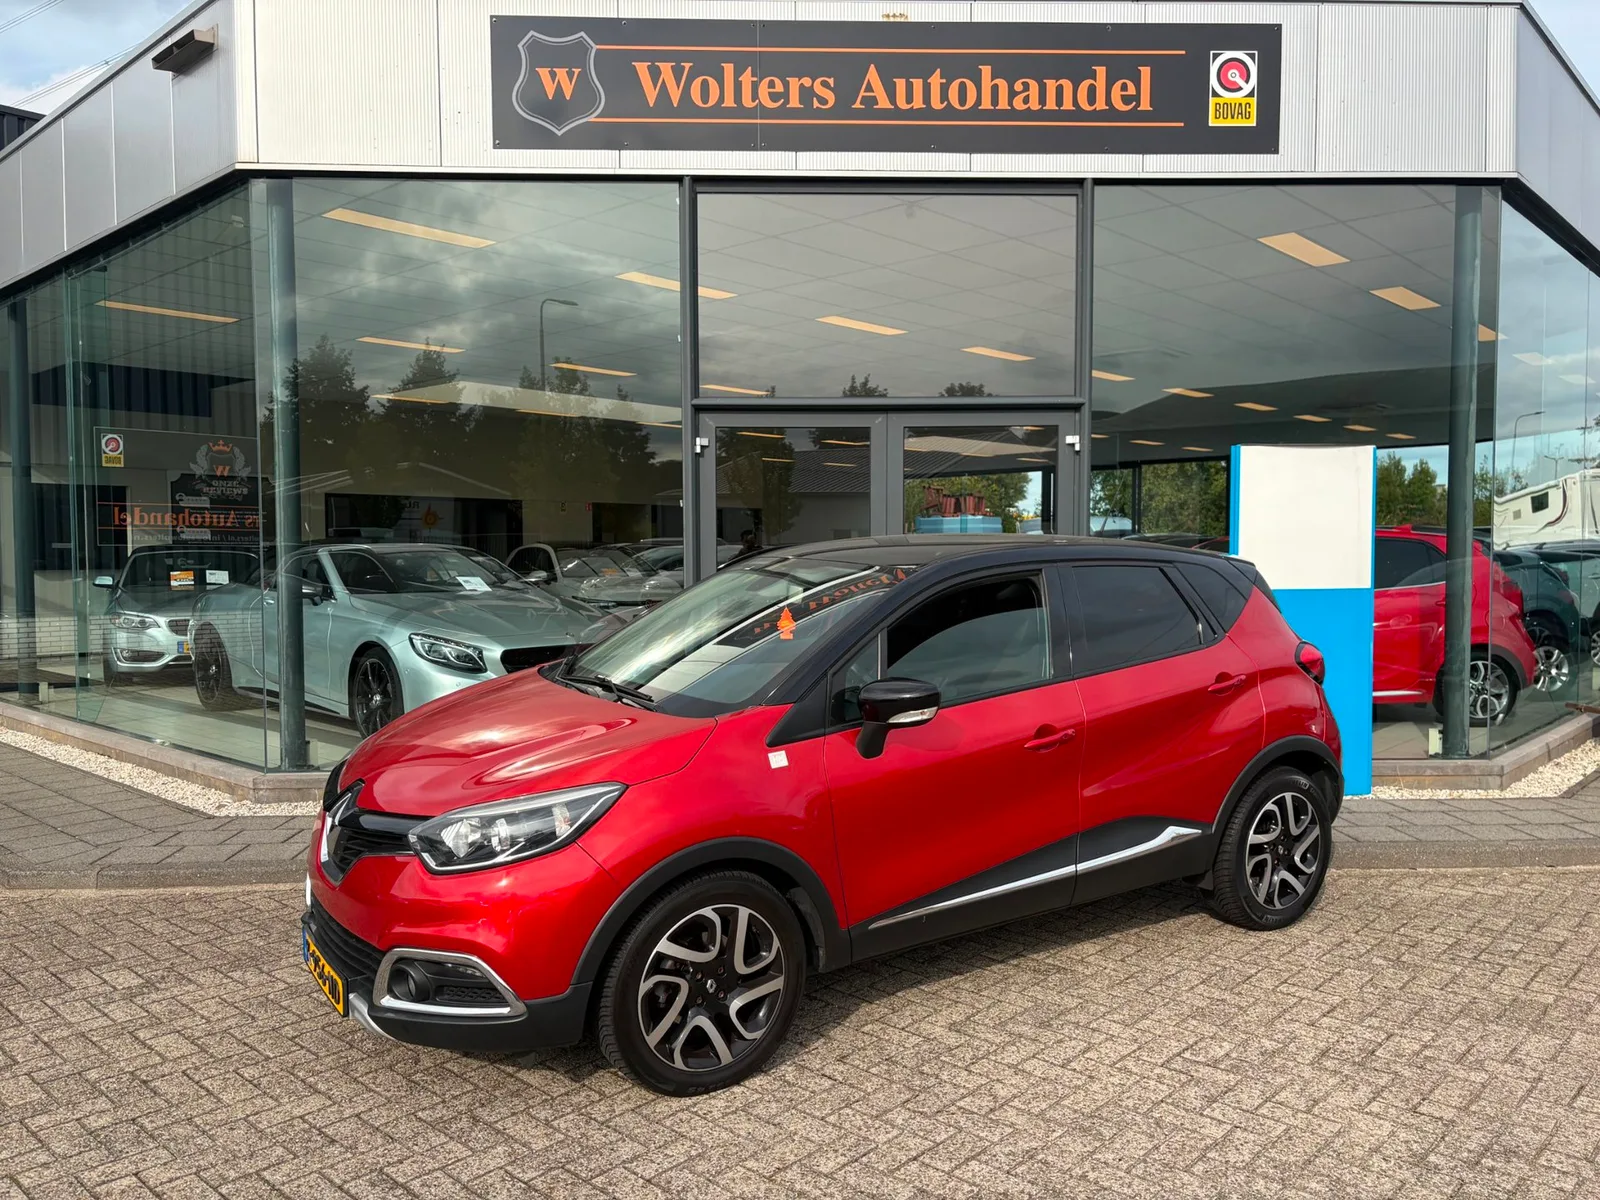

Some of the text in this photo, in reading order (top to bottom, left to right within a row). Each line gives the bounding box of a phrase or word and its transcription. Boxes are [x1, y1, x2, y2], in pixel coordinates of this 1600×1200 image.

[535, 67, 582, 101] W
[632, 61, 1153, 111] Wolters Autohandel
[1214, 102, 1252, 120] BOVAG
